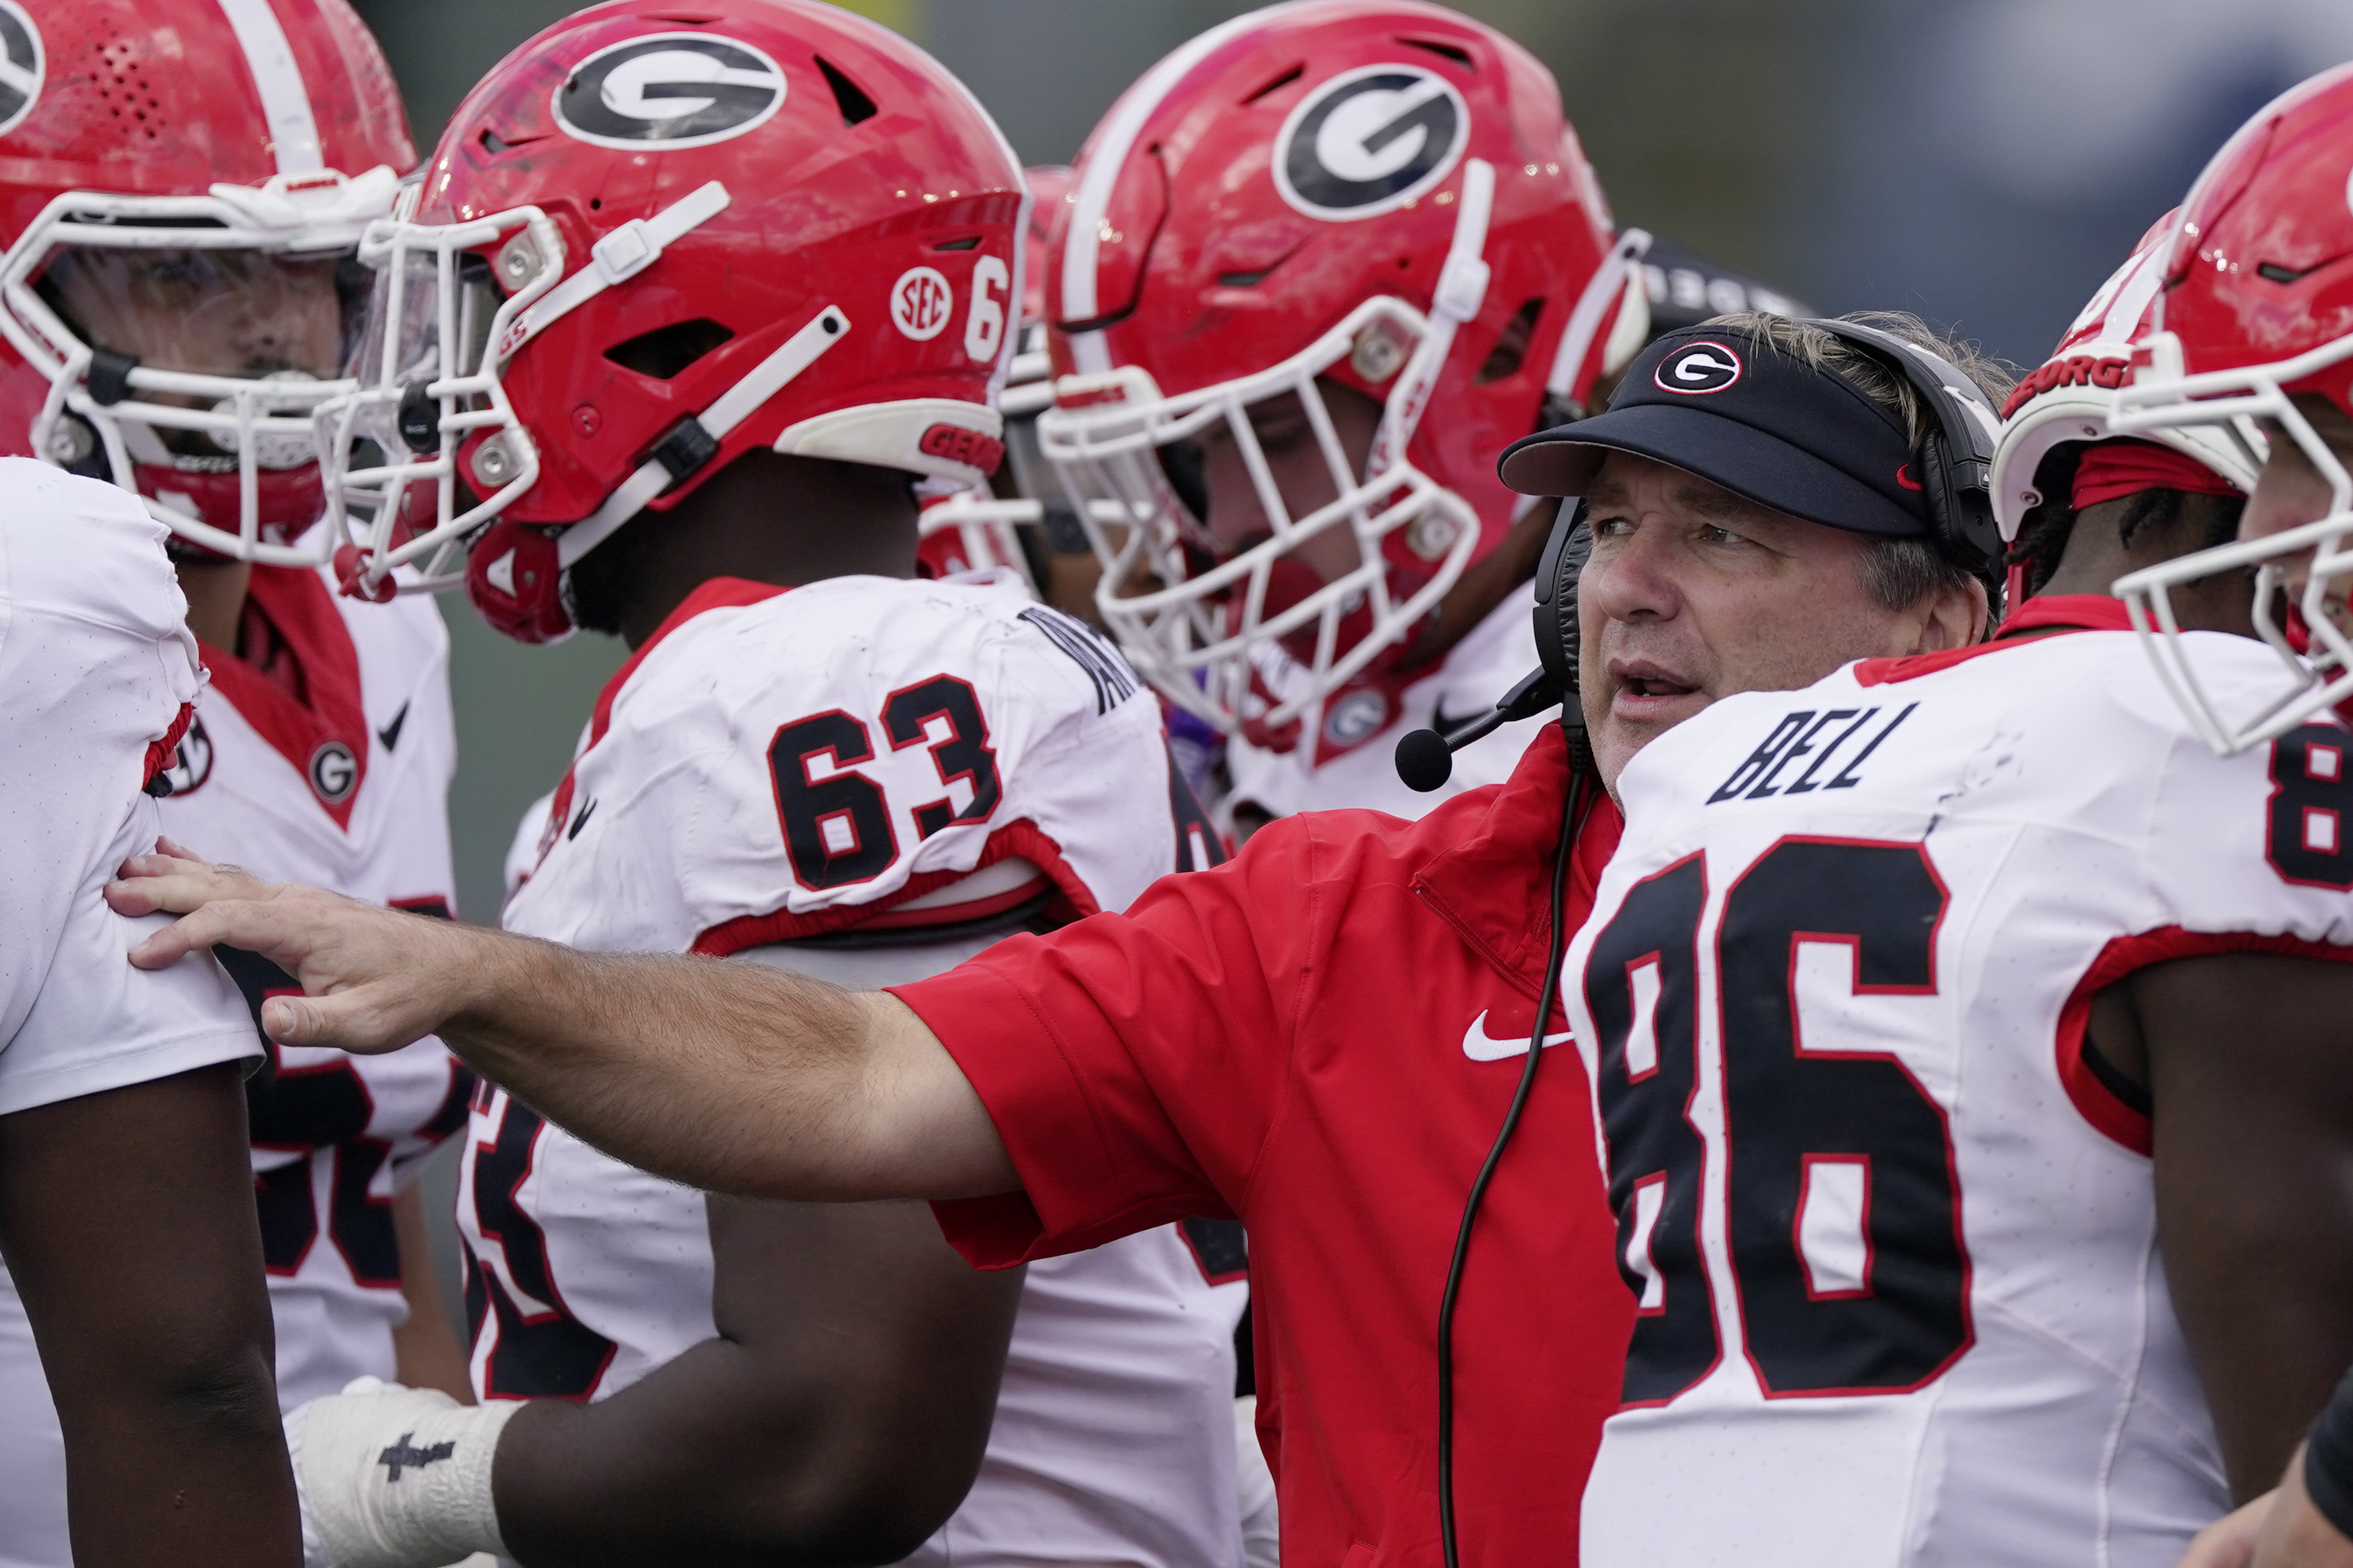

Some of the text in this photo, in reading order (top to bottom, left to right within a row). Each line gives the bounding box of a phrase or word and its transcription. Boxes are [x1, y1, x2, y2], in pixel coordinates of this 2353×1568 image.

[558, 37, 780, 143] G
[1285, 72, 1460, 210] G
[900, 275, 944, 330] SEC
[964, 255, 1010, 363] 6
[1657, 342, 1739, 391] G
[313, 749, 355, 797] G
[766, 672, 1002, 893] 63
[1704, 701, 1920, 806] BELL
[1583, 833, 1977, 1413] 86
